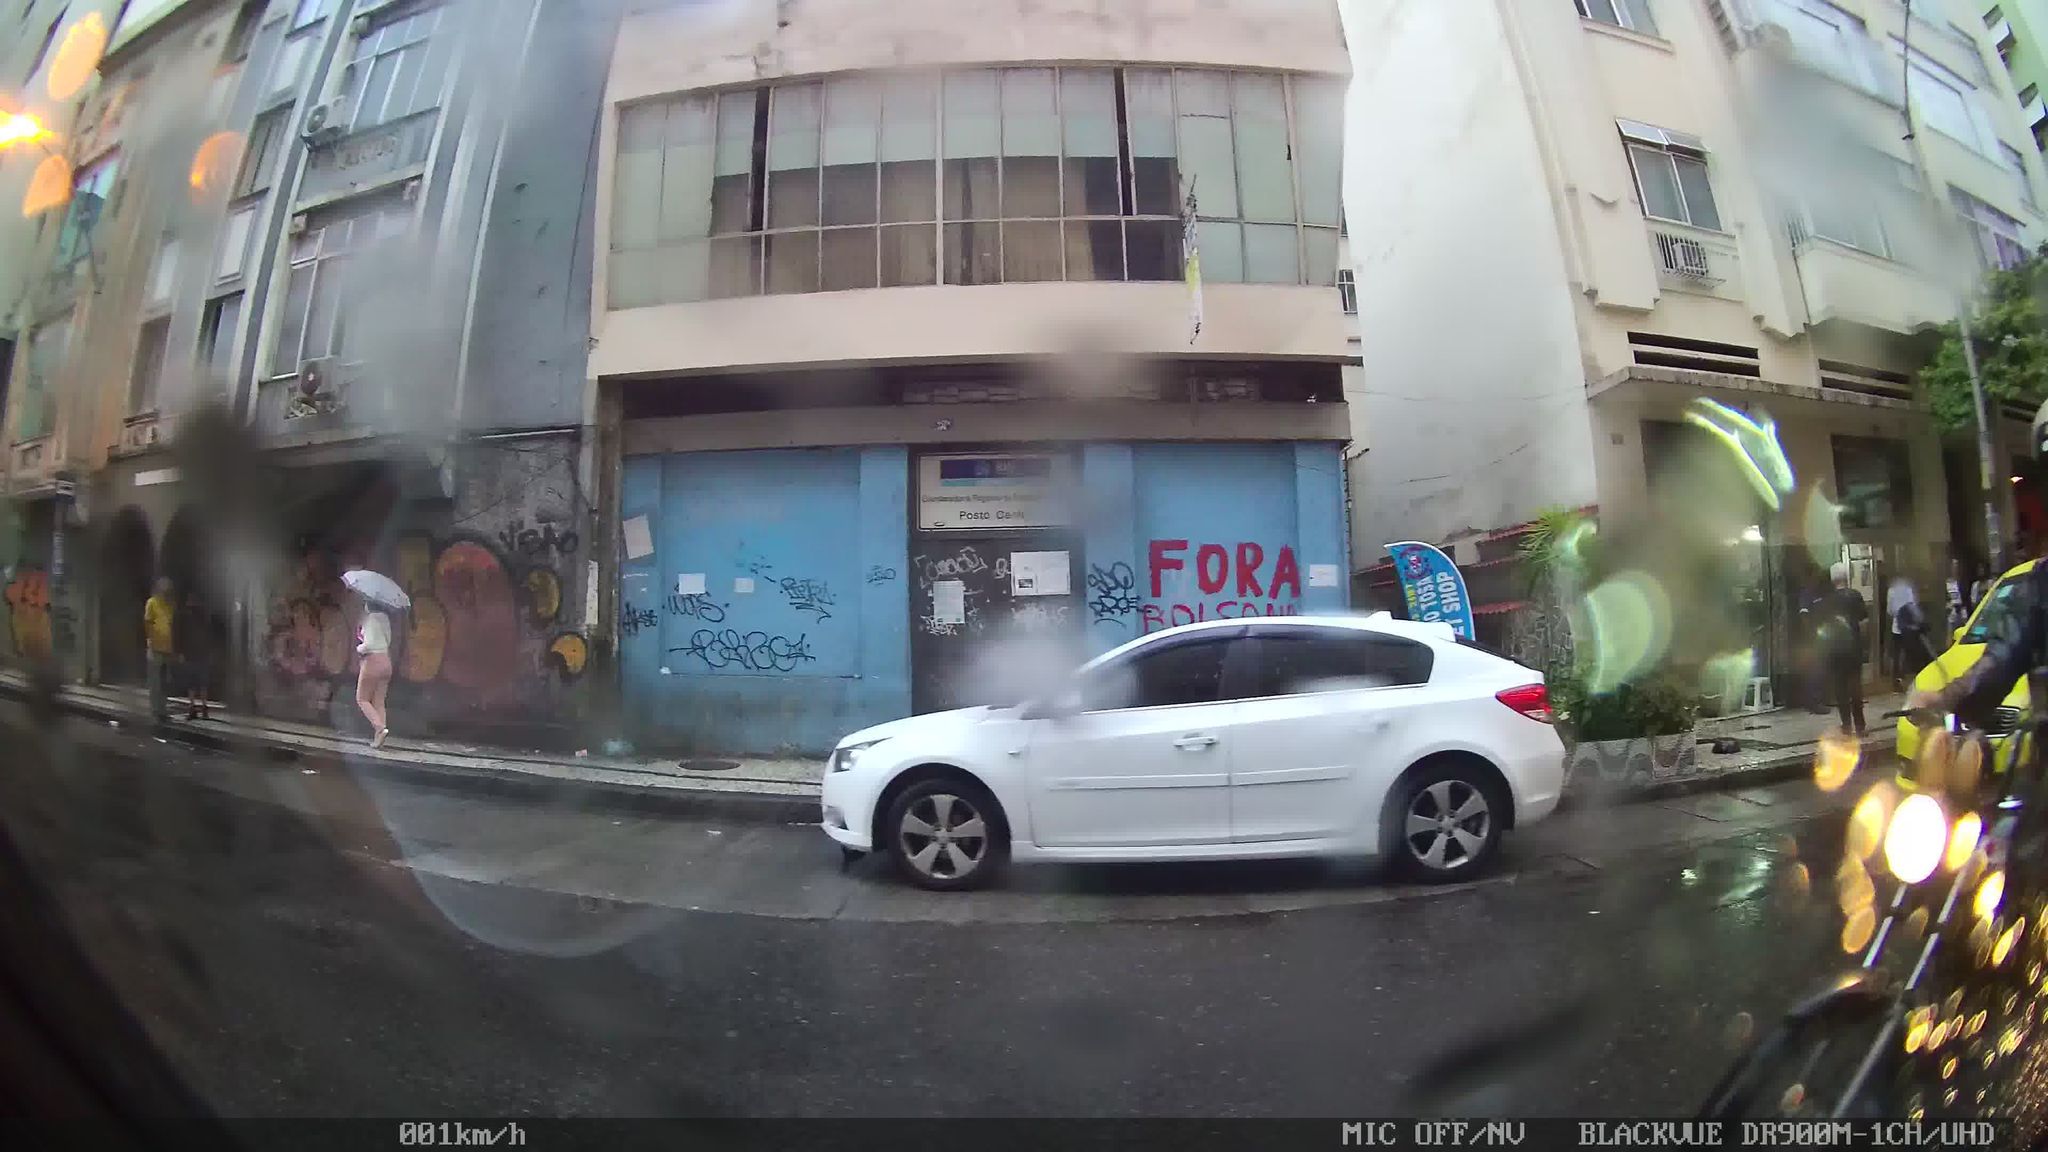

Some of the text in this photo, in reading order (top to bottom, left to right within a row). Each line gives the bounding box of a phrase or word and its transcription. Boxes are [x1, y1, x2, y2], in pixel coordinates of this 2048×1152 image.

[959, 510, 990, 520] Posto
[1149, 539, 1301, 599] FORA
[1435, 571, 1465, 636] ET SHOP
